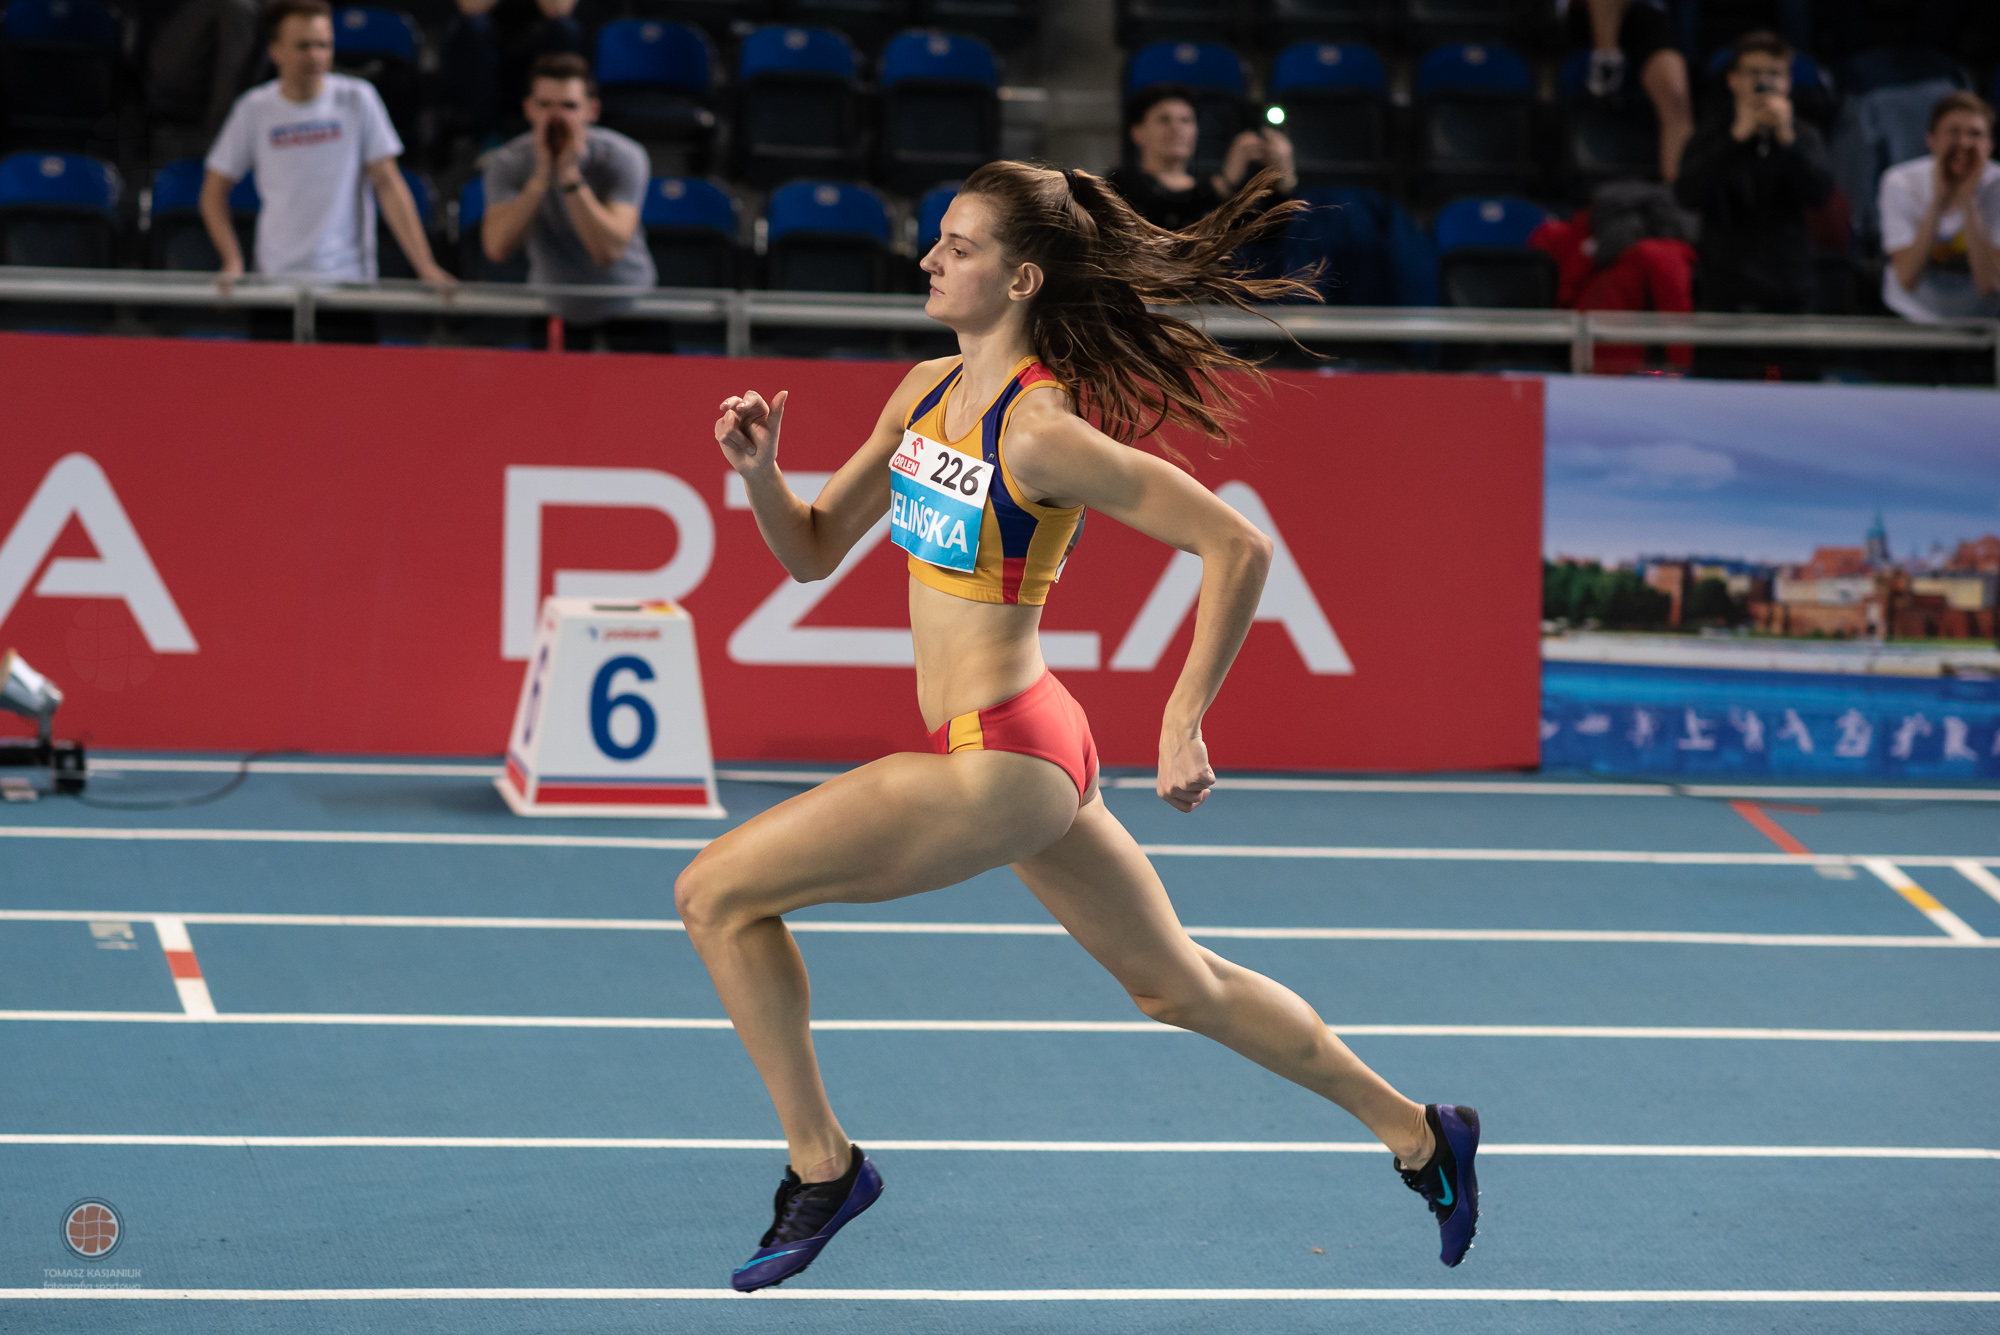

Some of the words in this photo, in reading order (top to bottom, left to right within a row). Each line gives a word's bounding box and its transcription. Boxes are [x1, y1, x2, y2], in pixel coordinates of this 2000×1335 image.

[894, 455, 919, 475] ORLEN
[930, 451, 983, 496] 226
[501, 465, 1354, 675] PZA
[589, 653, 657, 762] 6
